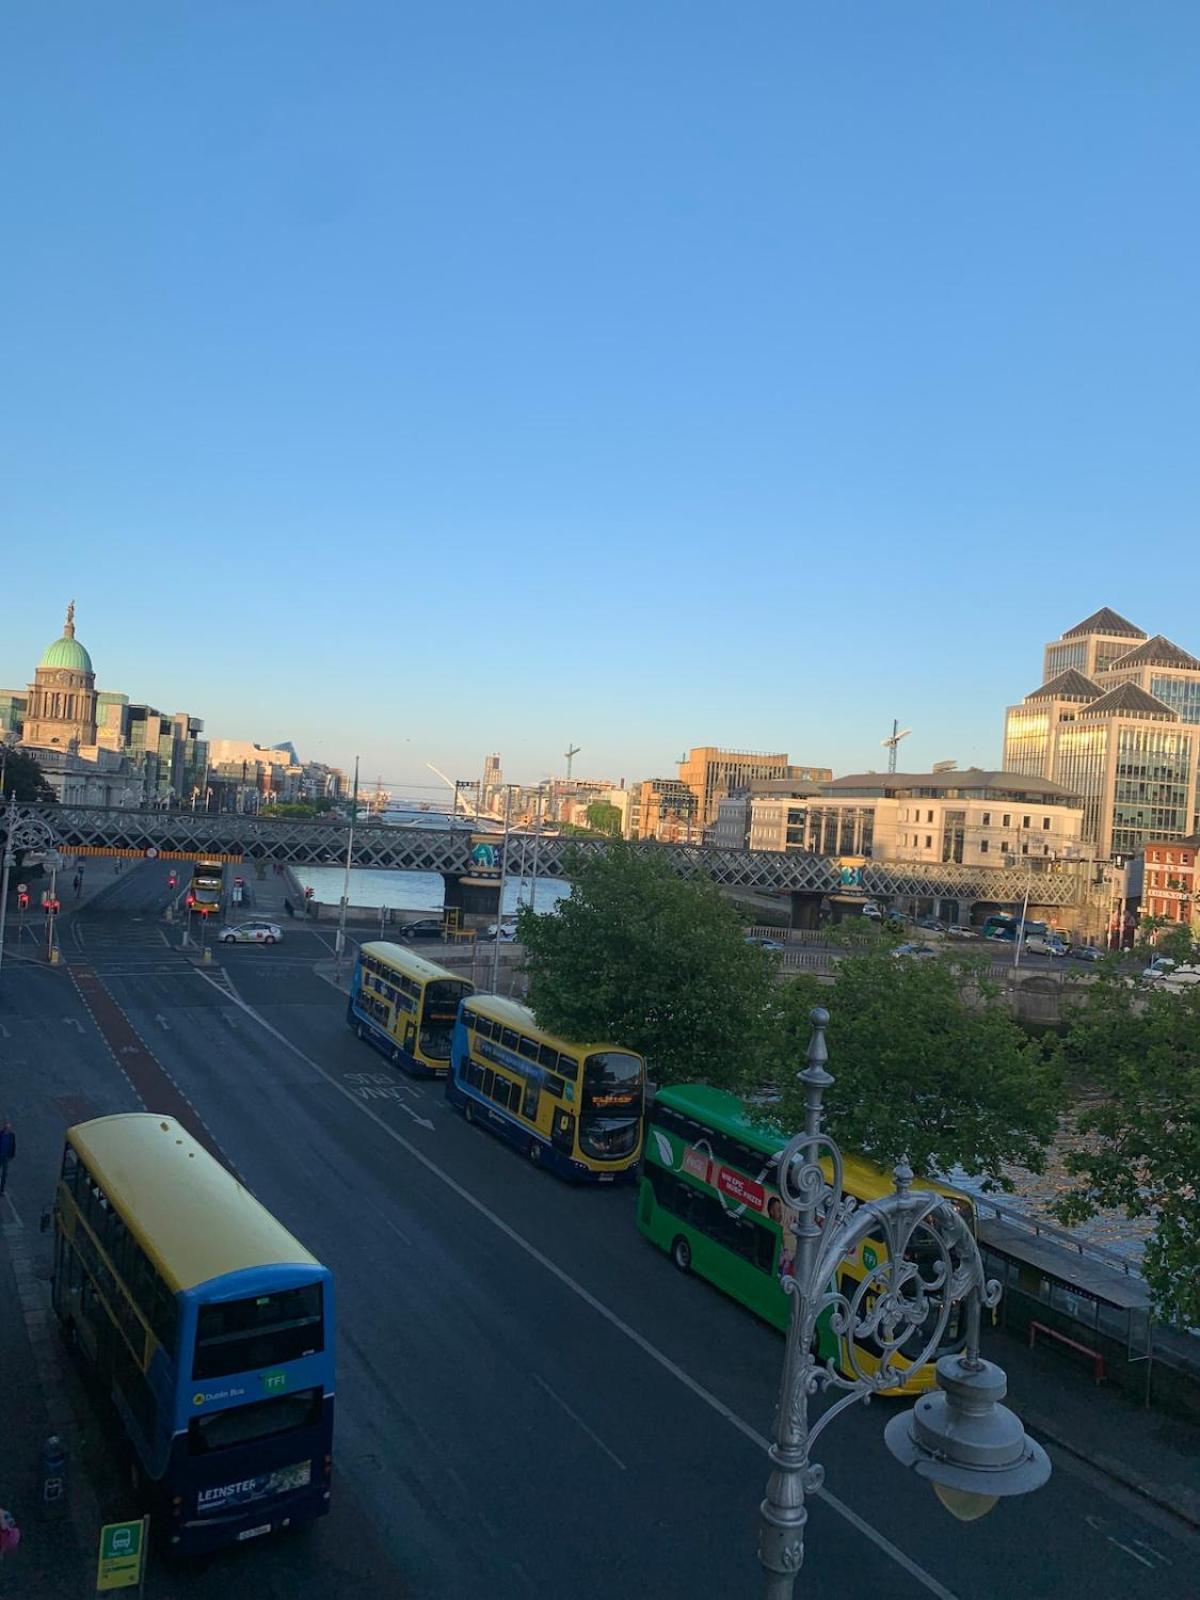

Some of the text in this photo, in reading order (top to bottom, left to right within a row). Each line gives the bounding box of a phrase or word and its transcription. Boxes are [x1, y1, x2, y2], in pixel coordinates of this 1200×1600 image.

[267, 1375, 286, 1388] TFI
[205, 1388, 245, 1401] Dublin Bus
[197, 1478, 257, 1503] LEINSTER
